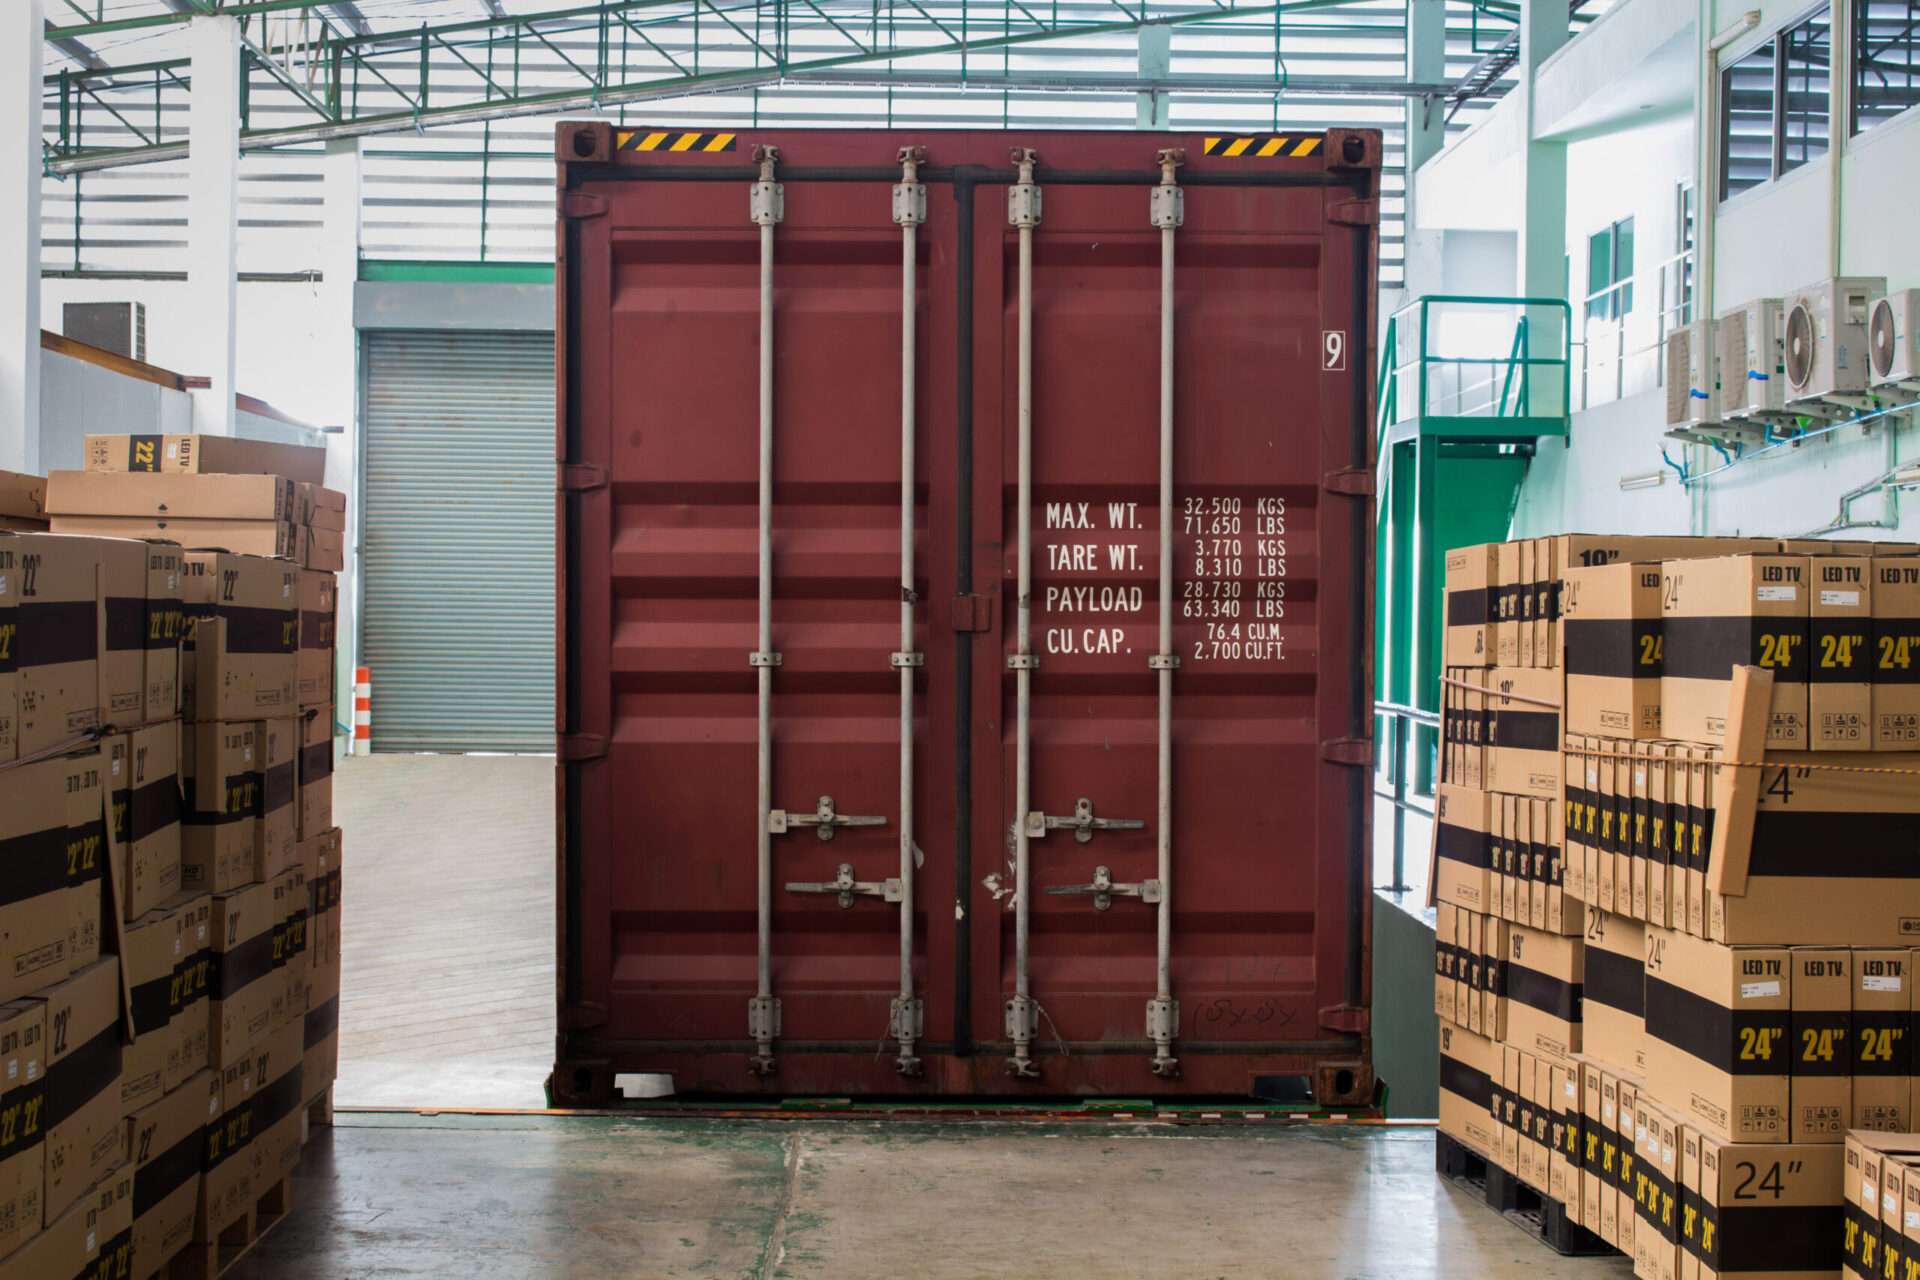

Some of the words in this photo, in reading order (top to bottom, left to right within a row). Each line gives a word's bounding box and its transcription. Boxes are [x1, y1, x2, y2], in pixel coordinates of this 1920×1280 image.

[1325, 333, 1342, 368] 9
[1046, 502, 1095, 529] MAX.
[1108, 502, 1143, 529] WT.
[1257, 497, 1286, 515] KGS
[1257, 517, 1286, 535] LBS
[1047, 544, 1098, 571] TARE
[1109, 544, 1144, 571] WT.
[1258, 539, 1287, 557] KGS
[1258, 558, 1287, 577] LBS
[1641, 573, 1660, 588] LED
[1762, 566, 1783, 582] LED
[1785, 566, 1801, 582] TV
[1822, 566, 1844, 583] LED
[1845, 567, 1861, 583] TV
[1880, 568, 1903, 584] LED
[1904, 568, 1919, 584] TV
[1046, 586, 1143, 612] PAYLOAD
[1257, 581, 1286, 599] KGS
[1565, 581, 1581, 613] 24"
[1664, 575, 1683, 610] 24"
[1256, 599, 1285, 618] LBS
[1206, 622, 1240, 641] 76.4
[1759, 634, 1802, 667] 24"
[1820, 635, 1863, 668] 24"
[1879, 635, 1920, 669] 24"
[1588, 908, 1608, 944] 24"
[1647, 934, 1666, 972] 24"
[1743, 959, 1763, 976] LED
[1765, 959, 1781, 976] TV
[1804, 960, 1824, 977] LED
[1827, 960, 1842, 977] TV
[1864, 960, 1883, 976] LED
[1886, 961, 1902, 977] TV
[1740, 1027, 1782, 1060] 24"
[1802, 1028, 1845, 1061] 24"
[1861, 1028, 1903, 1061] 24"
[1734, 1161, 1802, 1199] 24"
[1845, 1217, 1859, 1254] 24"
[1863, 1230, 1877, 1269] 24"
